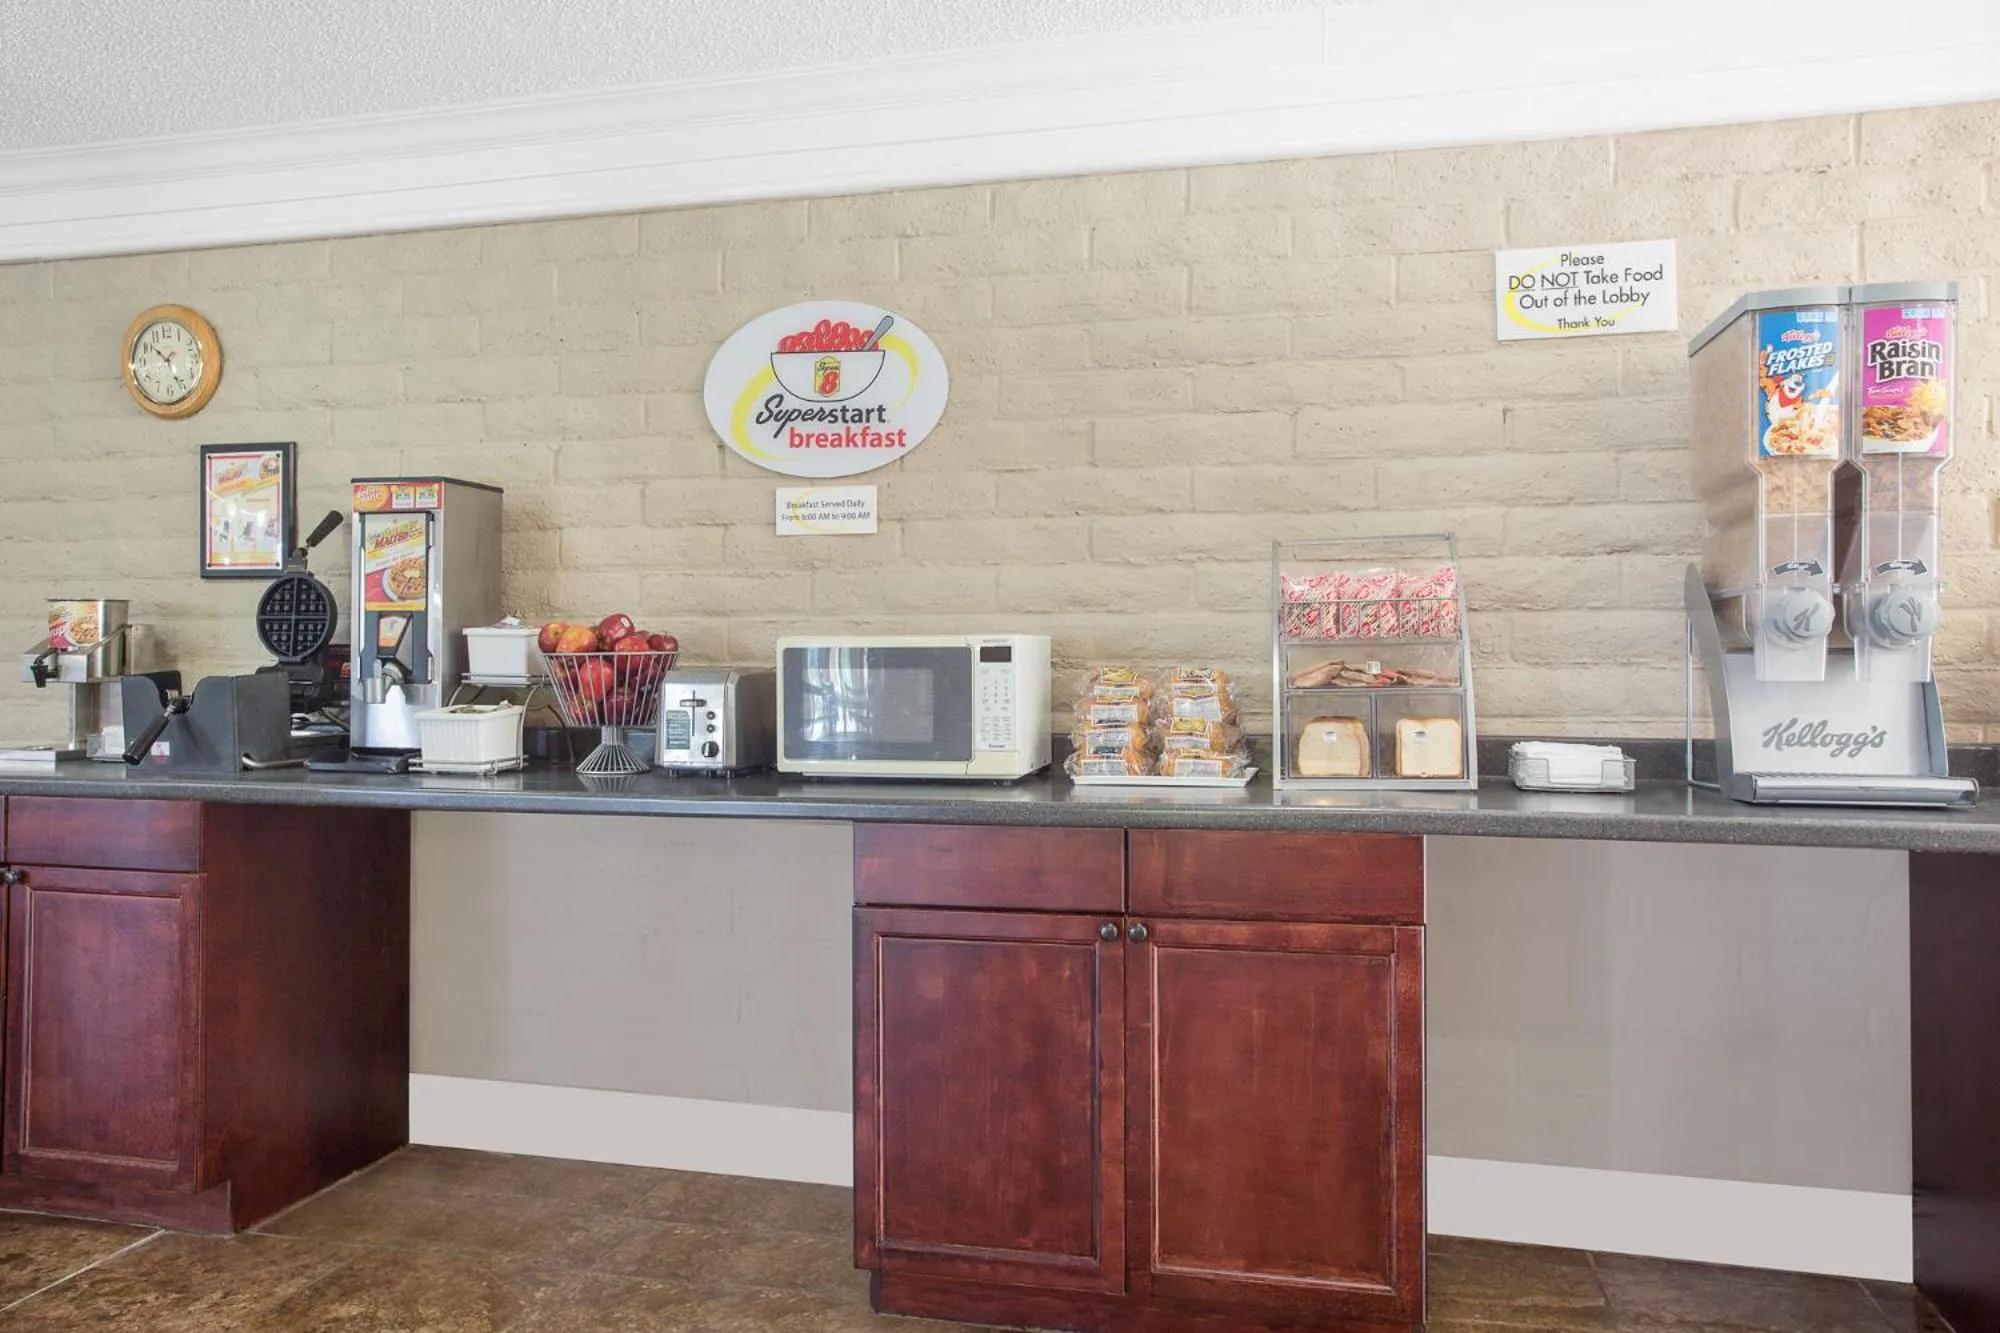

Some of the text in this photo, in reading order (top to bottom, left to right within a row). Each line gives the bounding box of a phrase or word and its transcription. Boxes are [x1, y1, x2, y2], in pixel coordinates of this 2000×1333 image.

[1560, 252, 1604, 267] Please
[1508, 264, 1663, 290] DO NOT Take Food
[1519, 286, 1650, 309] Out of the Lobby
[161, 325, 172, 339] 12
[1557, 317, 1616, 330] Thank You
[1766, 341, 1833, 366] FROSTED
[1870, 340, 1941, 364] Raisin
[1768, 355, 1825, 377] FLAKES
[1879, 360, 1934, 381] Bran
[819, 372, 839, 396] 8
[756, 394, 887, 439] Superstart
[789, 426, 907, 449] breakfast
[820, 500, 845, 508] Served
[847, 499, 866, 508] Daily
[818, 512, 830, 520] AM
[858, 511, 870, 519] AM
[1762, 717, 1887, 758] Kellogg's
